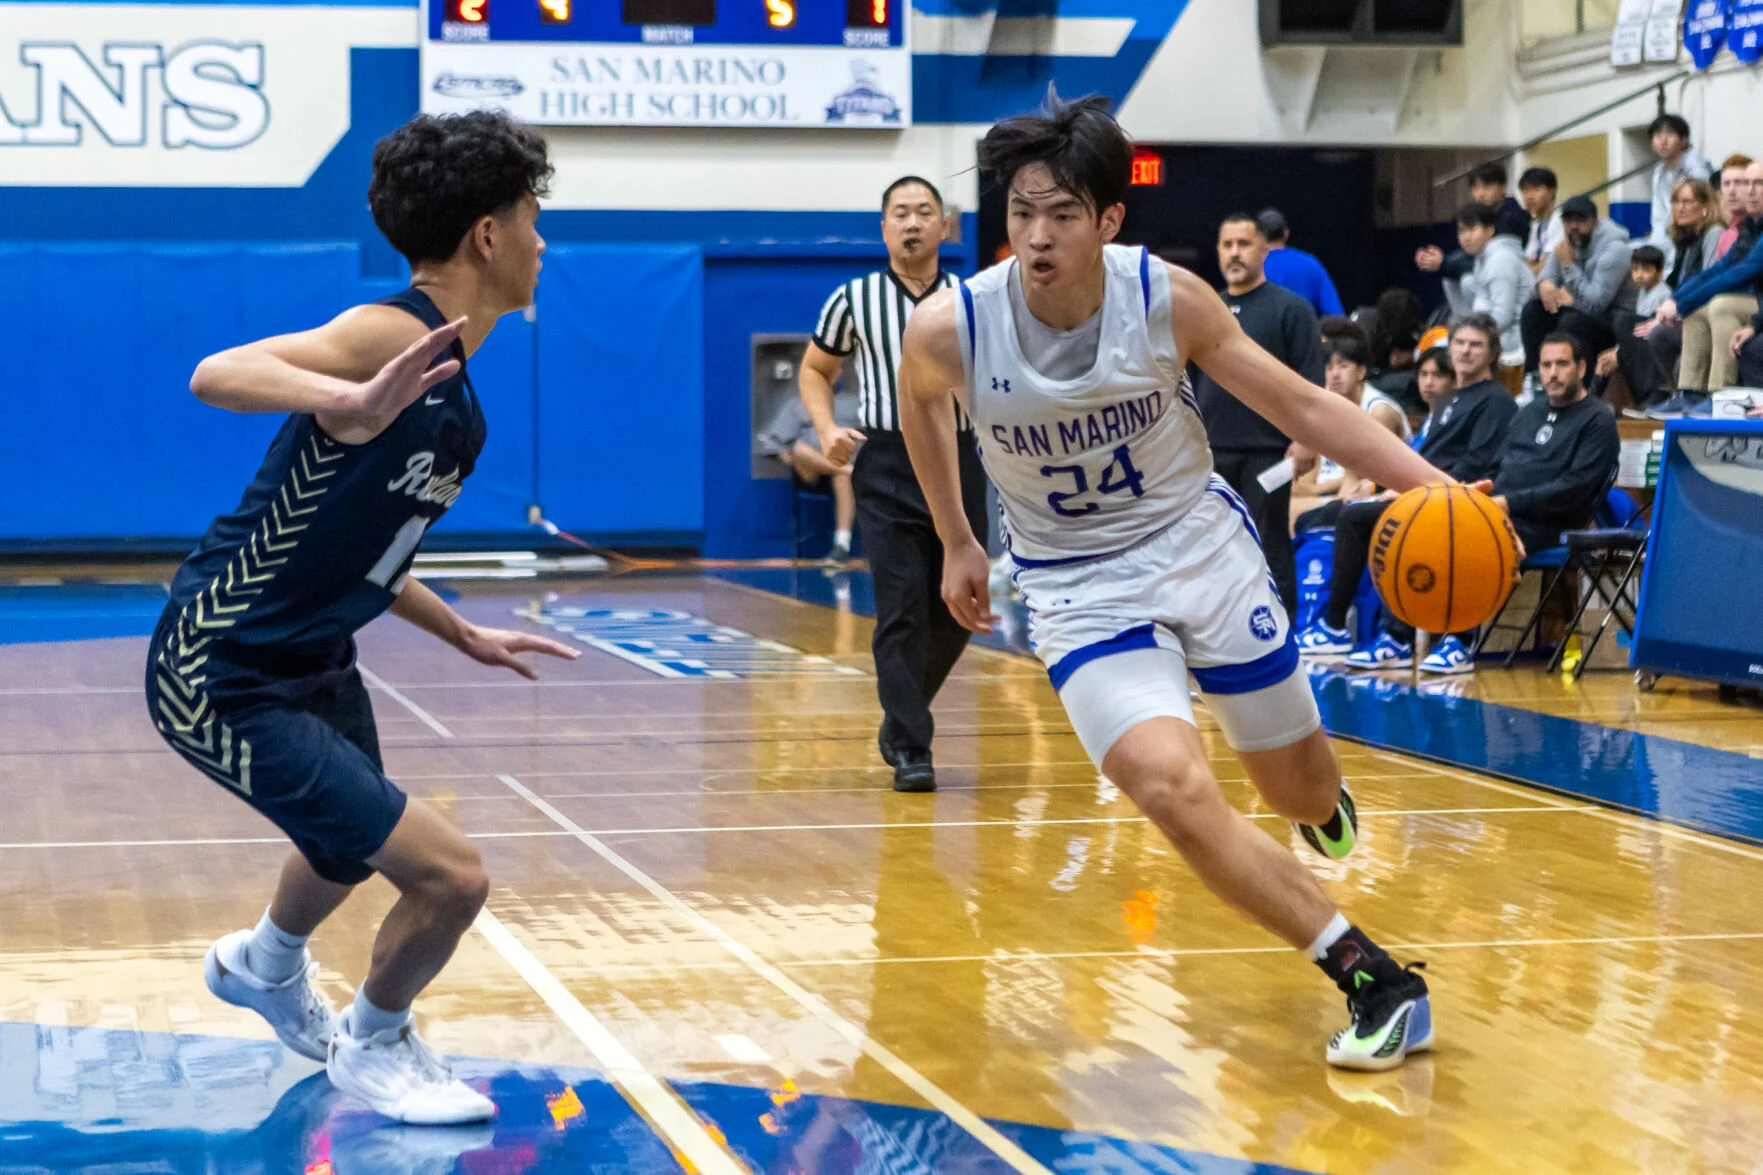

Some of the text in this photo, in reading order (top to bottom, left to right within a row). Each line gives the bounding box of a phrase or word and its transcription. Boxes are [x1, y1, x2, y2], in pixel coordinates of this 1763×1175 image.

[0, 37, 271, 151] NS
[551, 56, 787, 86] SAN MARINO
[539, 90, 800, 122] HIGH SCHOOL
[1131, 158, 1161, 185] EXIT
[991, 389, 1163, 457] SAN MARINO
[1039, 443, 1146, 518] 24
[364, 514, 431, 595] 1
